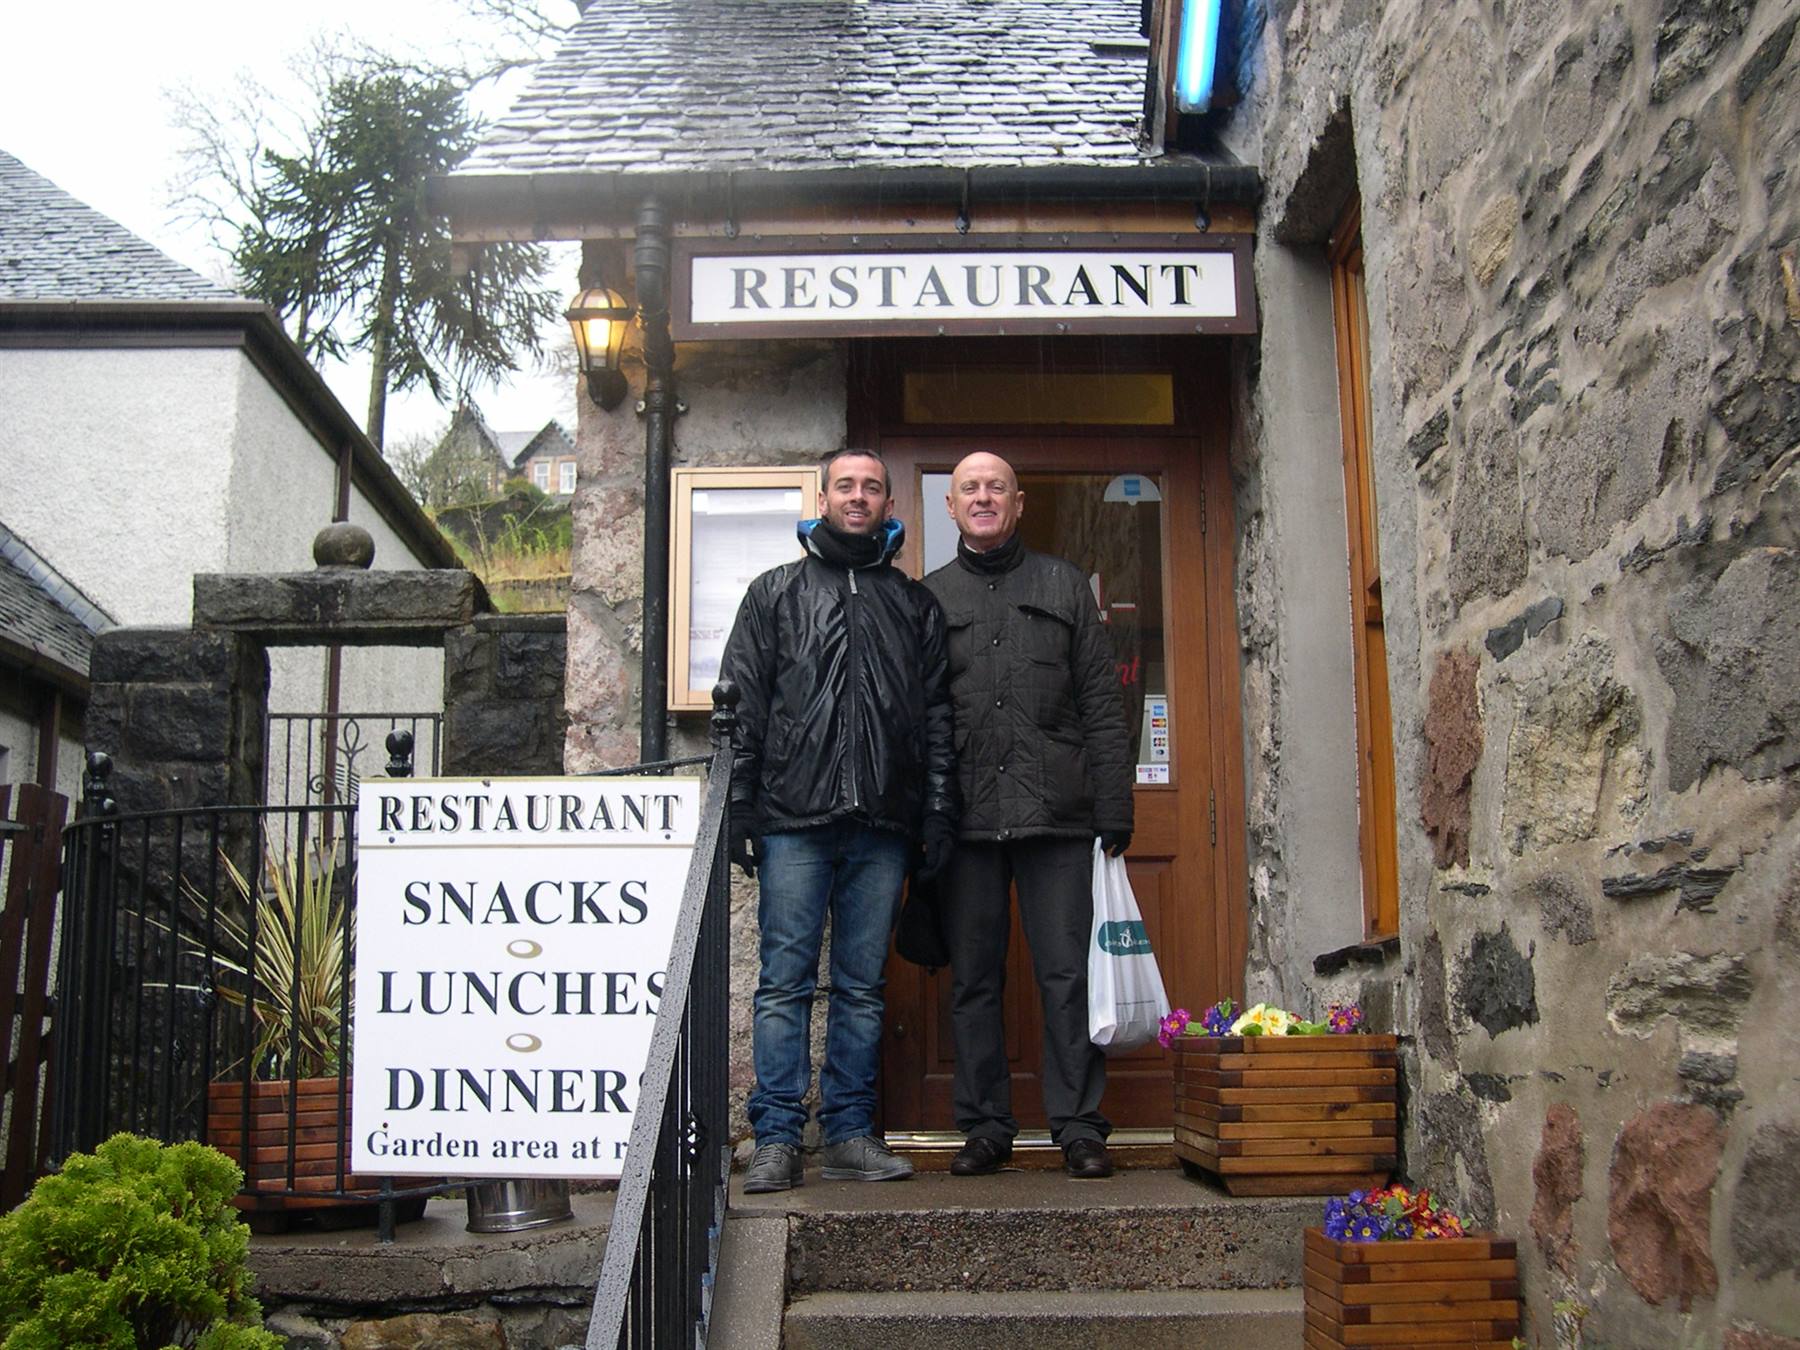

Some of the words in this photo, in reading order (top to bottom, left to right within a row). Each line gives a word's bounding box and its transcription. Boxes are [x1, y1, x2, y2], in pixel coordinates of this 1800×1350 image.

[730, 263, 1201, 309] RESTAURANT
[378, 794, 682, 833] RESTAURANT
[402, 880, 649, 926] SNACKS
[384, 1067, 645, 1114] DINNER
[366, 1130, 480, 1158] Garden
[492, 1139, 559, 1160] area
[571, 1135, 601, 1160] at
